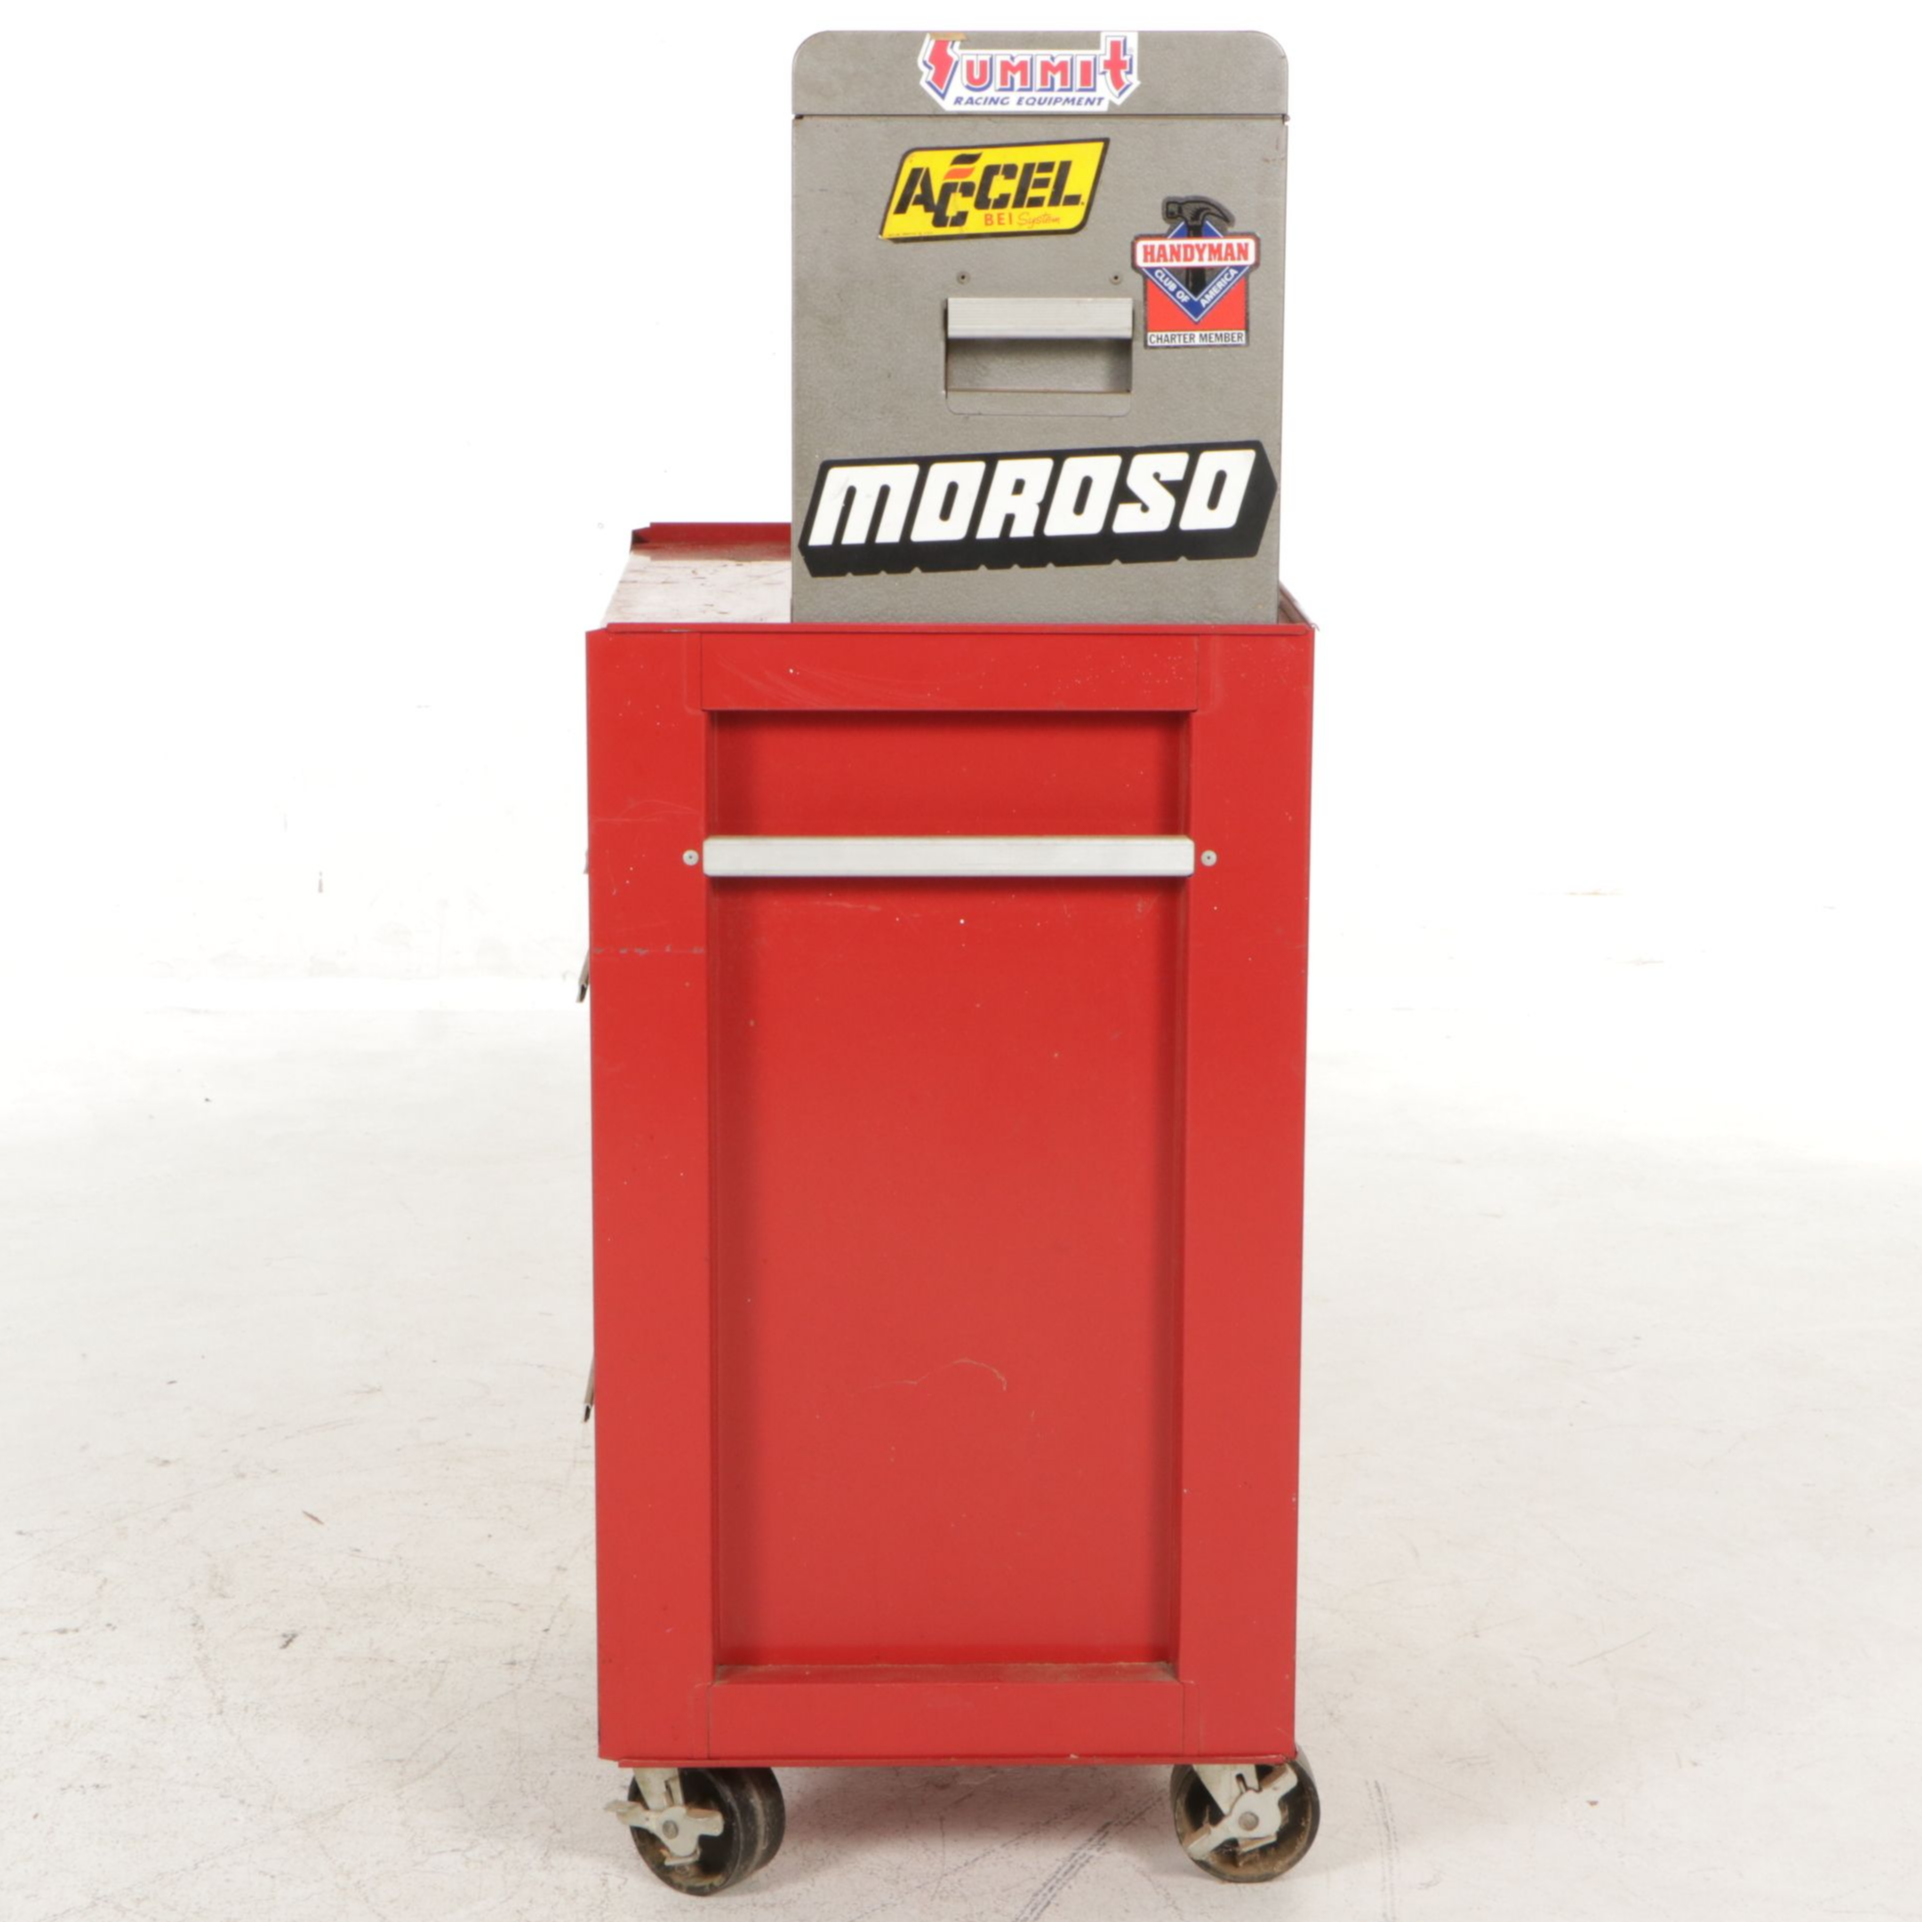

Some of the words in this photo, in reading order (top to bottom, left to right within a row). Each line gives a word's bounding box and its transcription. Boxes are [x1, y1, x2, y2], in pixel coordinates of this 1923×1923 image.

[953, 96, 1010, 106] RACING
[1016, 96, 1105, 107] EQUIPMENT
[893, 160, 1084, 228] ACCEL
[984, 212, 1013, 226] BEI
[1142, 242, 1249, 263] HANDYMAN
[1154, 269, 1178, 293] CLUB
[1176, 289, 1191, 303] OF
[1200, 267, 1239, 308] AMERICA
[1149, 333, 1196, 344] CHARTER
[1199, 332, 1244, 342] MEMBER
[808, 450, 1256, 546] MOROSO
